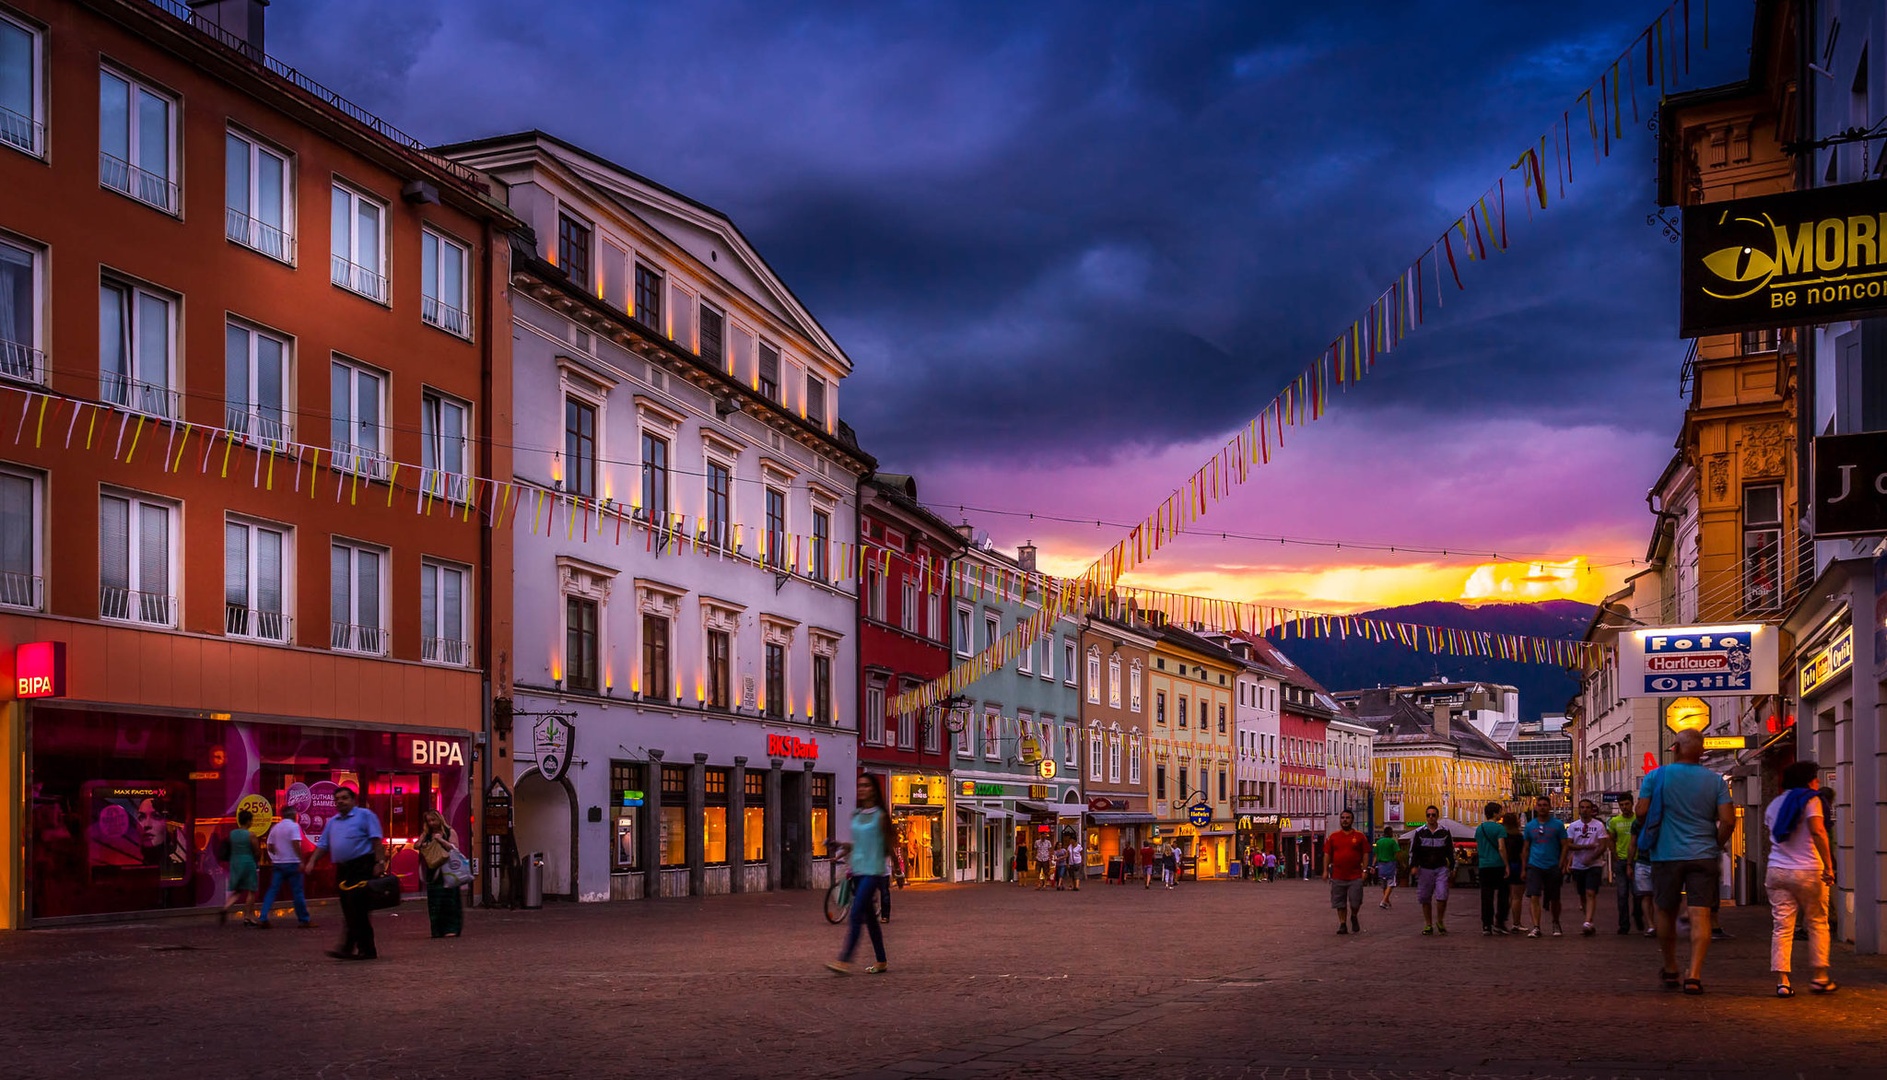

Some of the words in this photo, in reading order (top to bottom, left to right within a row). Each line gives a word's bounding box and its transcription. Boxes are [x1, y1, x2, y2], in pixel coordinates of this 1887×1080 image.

[1771, 291, 1797, 308] Be
[1651, 636, 1739, 650] Foto
[1654, 656, 1723, 670] Hartlauer
[19, 676, 52, 695] BIPA
[1651, 675, 1746, 691] Optik
[412, 739, 464, 766] BIPA
[767, 734, 792, 757] BKS
[792, 736, 819, 759] Bank
[1563, 762, 1571, 802] HOTEL
